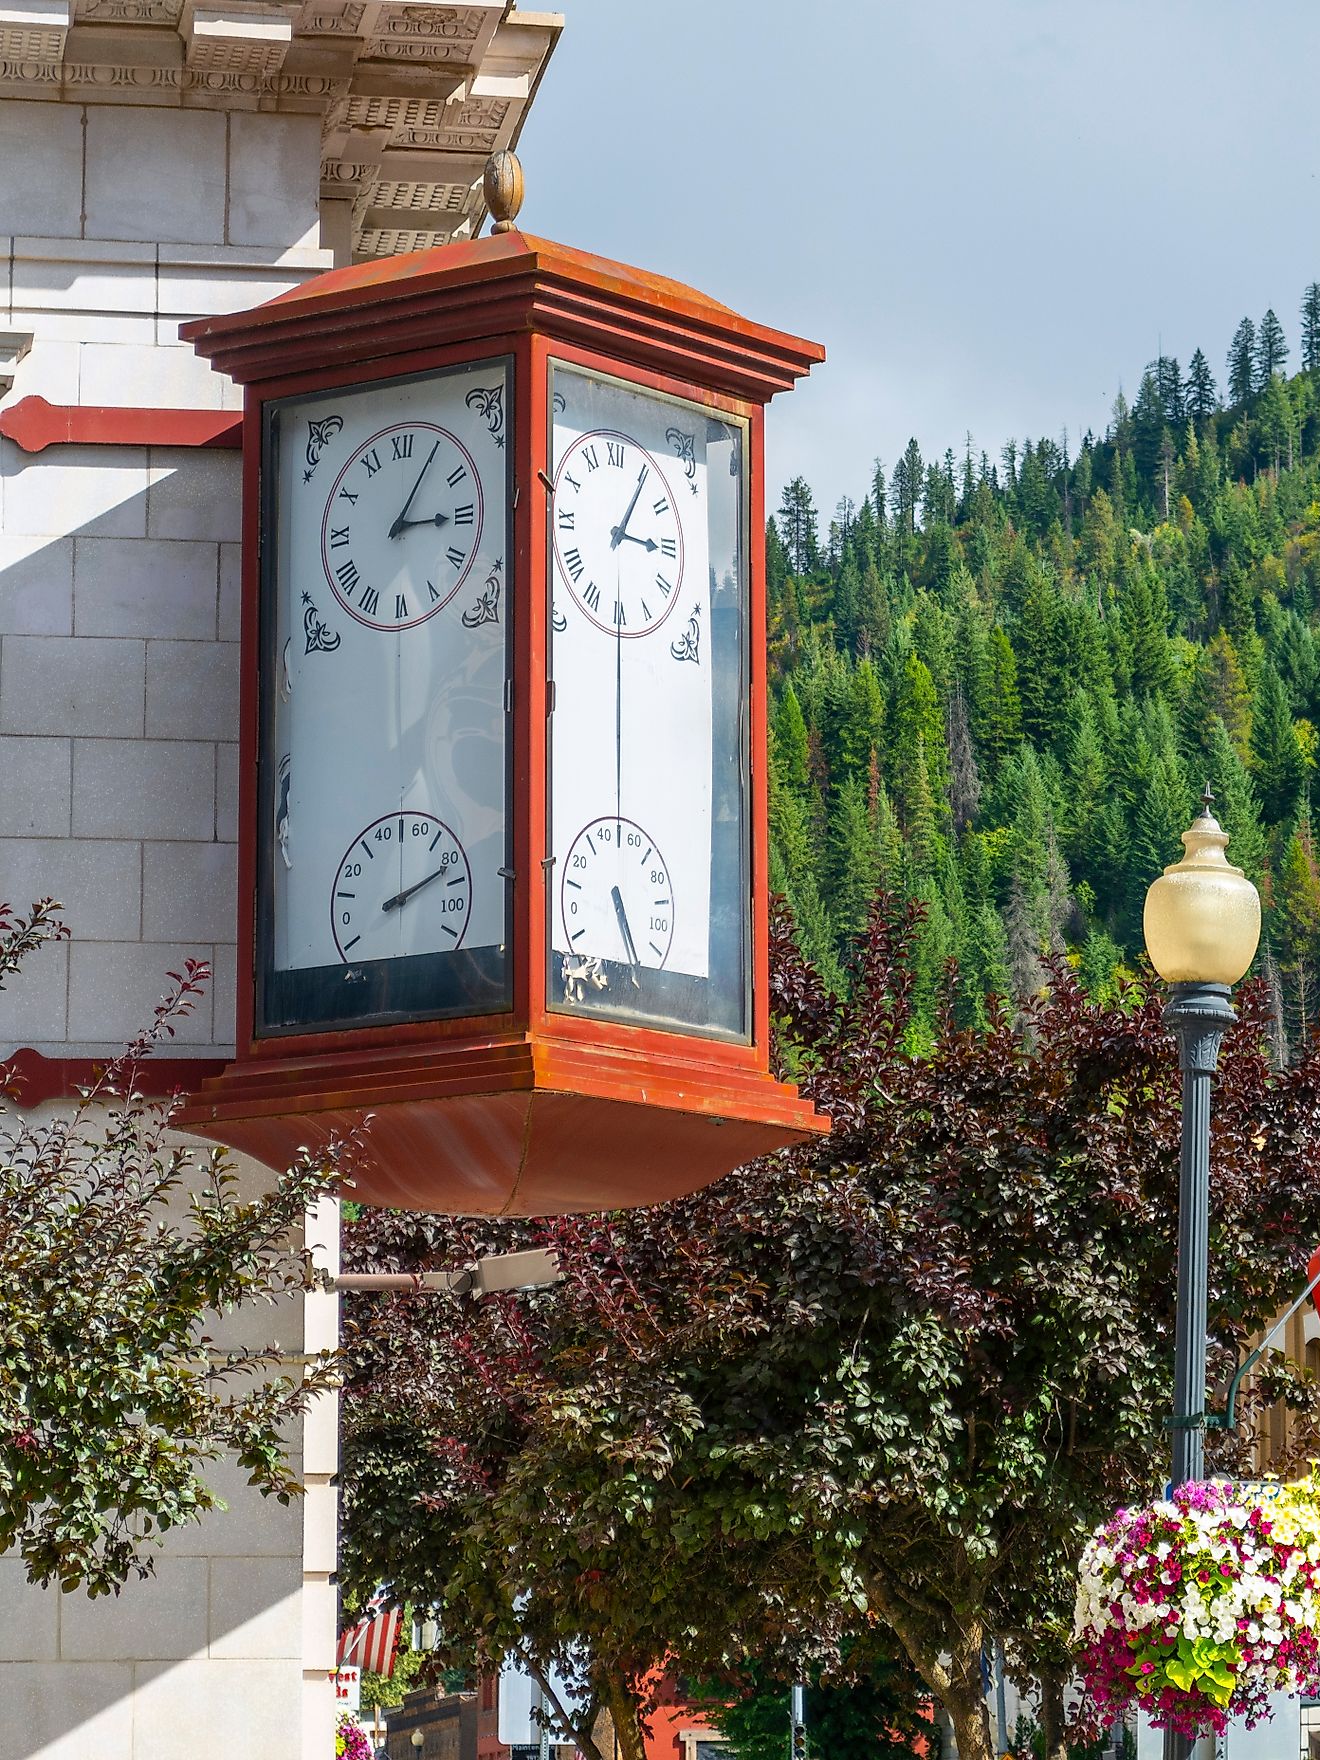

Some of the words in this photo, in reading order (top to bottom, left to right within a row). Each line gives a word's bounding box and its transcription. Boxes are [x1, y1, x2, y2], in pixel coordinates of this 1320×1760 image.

[391, 434, 414, 461] XII
[581, 444, 600, 472] XI
[606, 442, 624, 468] XII
[360, 449, 382, 478] XI
[446, 465, 467, 488] II
[564, 471, 581, 493] X
[339, 487, 358, 506] X
[653, 497, 670, 516] II
[454, 504, 474, 525] III
[558, 508, 575, 530] IX
[330, 526, 350, 549] IX
[661, 538, 676, 559] III
[446, 546, 466, 570] IV
[564, 548, 585, 583] VIII
[336, 560, 360, 596] VIII
[655, 572, 672, 598] IV
[358, 586, 380, 616] VII
[426, 580, 440, 602] V
[582, 580, 601, 612] VII
[395, 594, 408, 618] VI
[614, 600, 626, 625] VI
[640, 598, 652, 621] V
[374, 827, 392, 841] 40
[412, 822, 429, 836] 60
[597, 828, 611, 842] 40
[627, 834, 641, 847] 60
[441, 850, 459, 865] 80
[572, 854, 586, 868] 20
[344, 864, 362, 878] 20
[650, 870, 664, 884] 80
[441, 898, 464, 913] 100
[571, 902, 578, 914] 0
[342, 912, 350, 925] 0
[650, 918, 668, 932] 100
